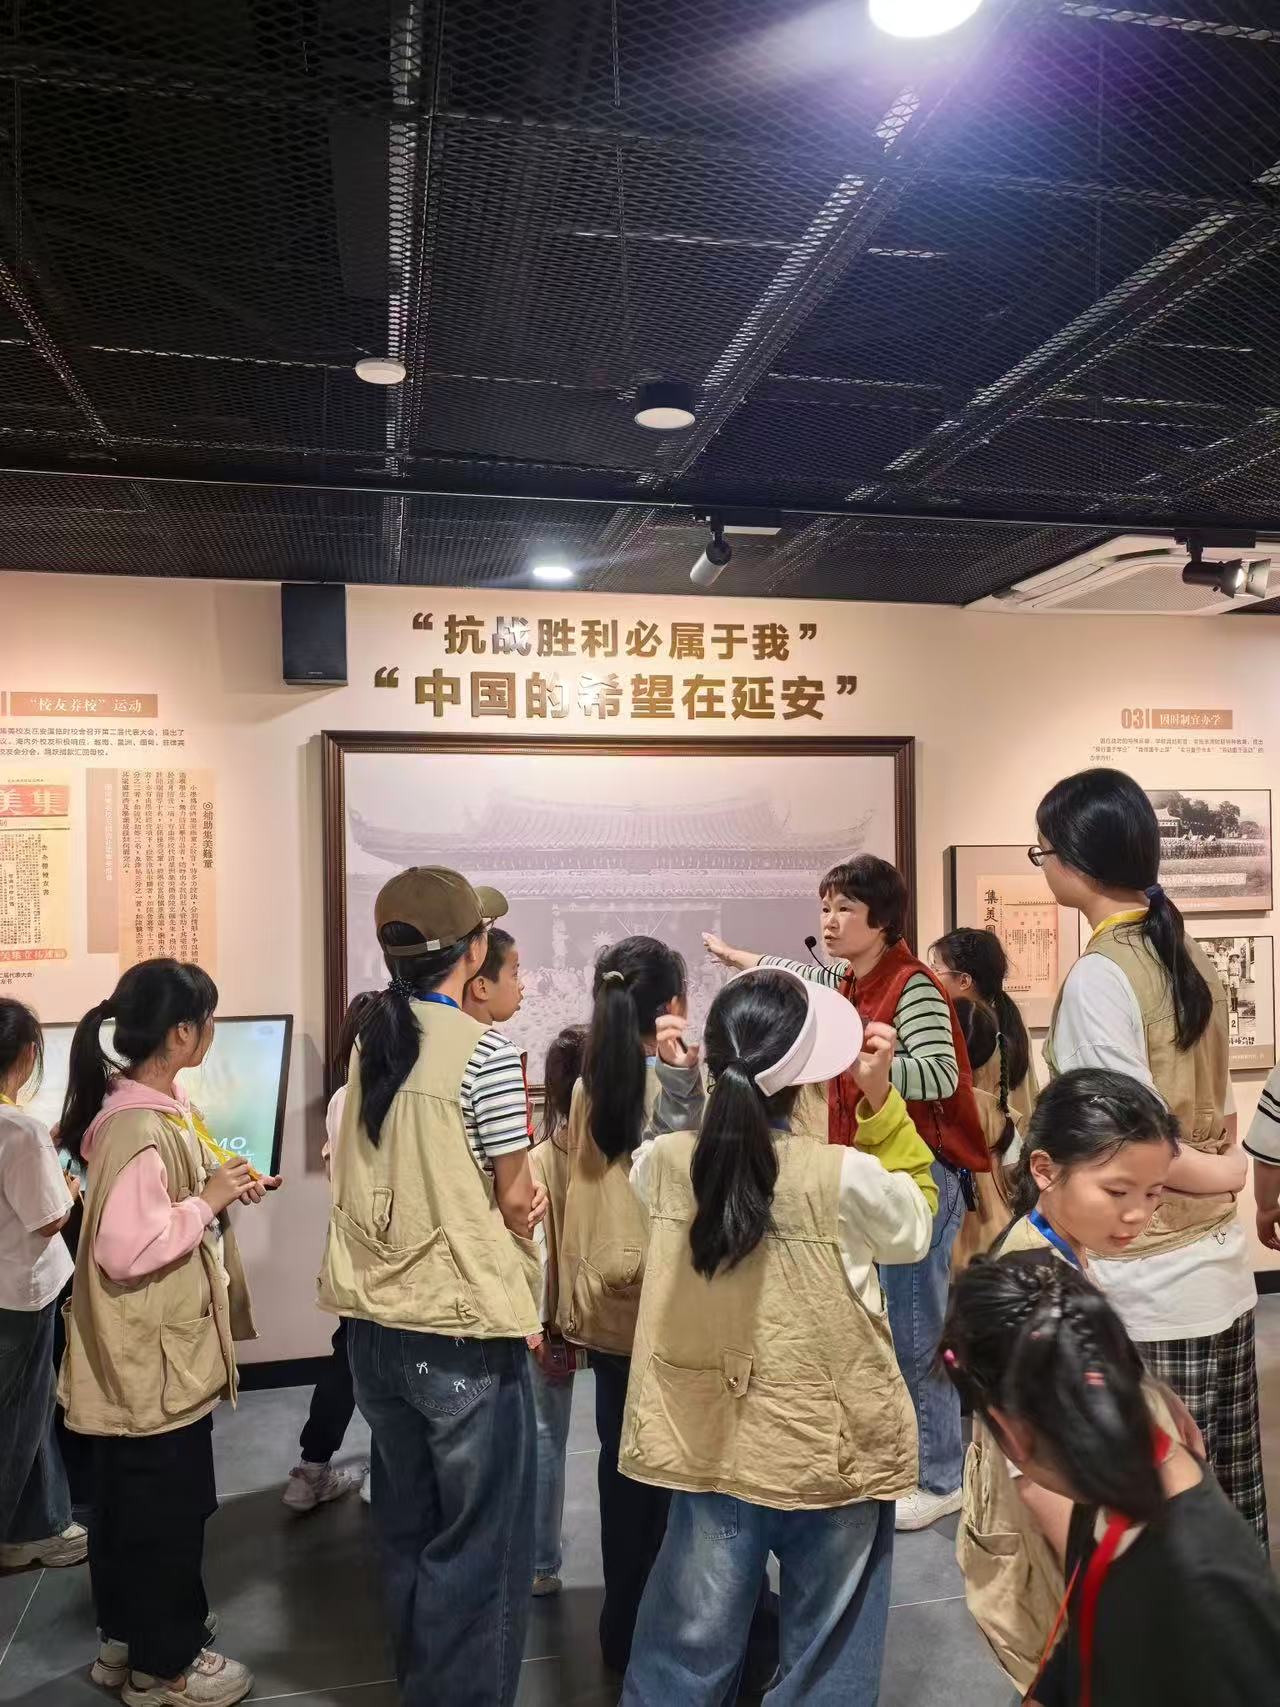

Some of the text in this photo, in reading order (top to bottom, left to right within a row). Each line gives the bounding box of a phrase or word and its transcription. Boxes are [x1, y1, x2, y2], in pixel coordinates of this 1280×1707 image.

[412, 612, 817, 662] “抗战胜利必属于我”
[374, 665, 858, 721] “中国的希望在延安”
[1231, 1020, 1237, 1028] 2
